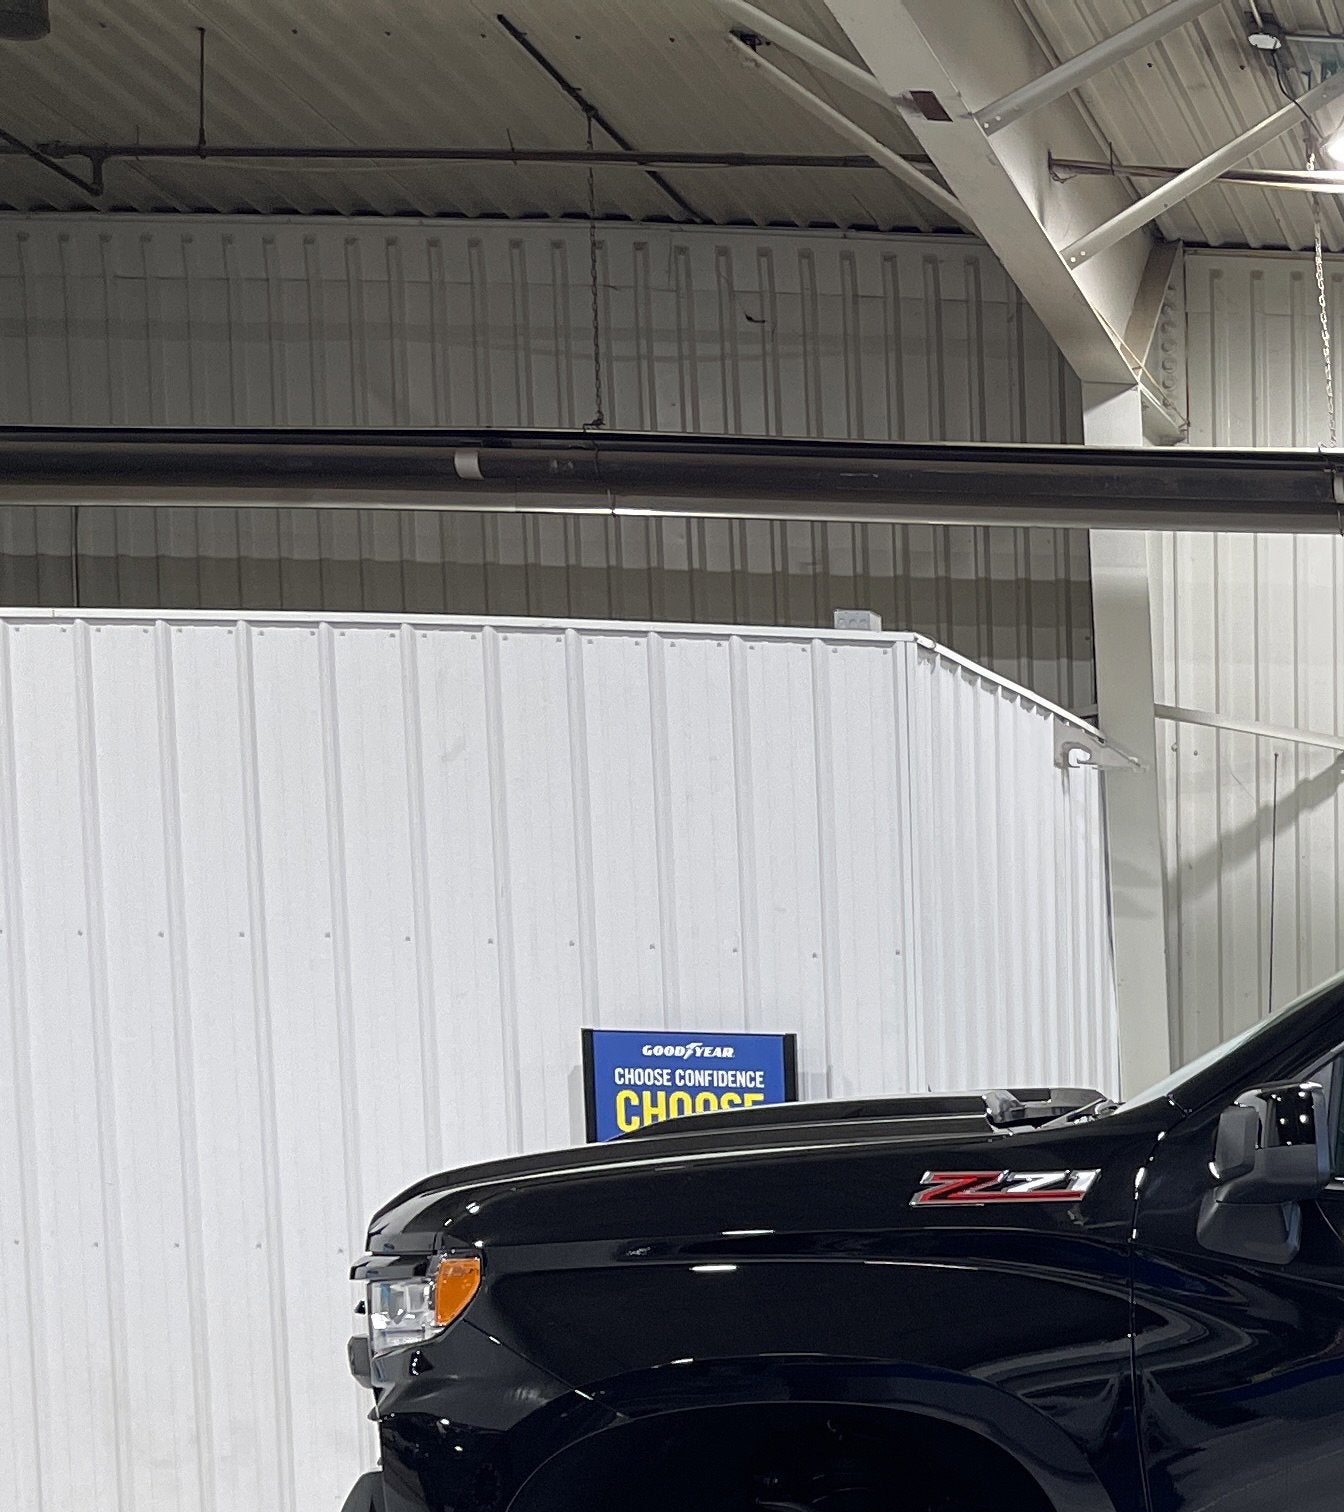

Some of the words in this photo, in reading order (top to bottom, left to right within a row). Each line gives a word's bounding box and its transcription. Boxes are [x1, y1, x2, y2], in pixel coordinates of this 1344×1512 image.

[641, 1042, 736, 1060] GOODYEAR
[614, 1067, 672, 1086] CHOOSE
[674, 1069, 765, 1088] CONFIDENCE
[909, 1169, 1101, 1208] Z71
